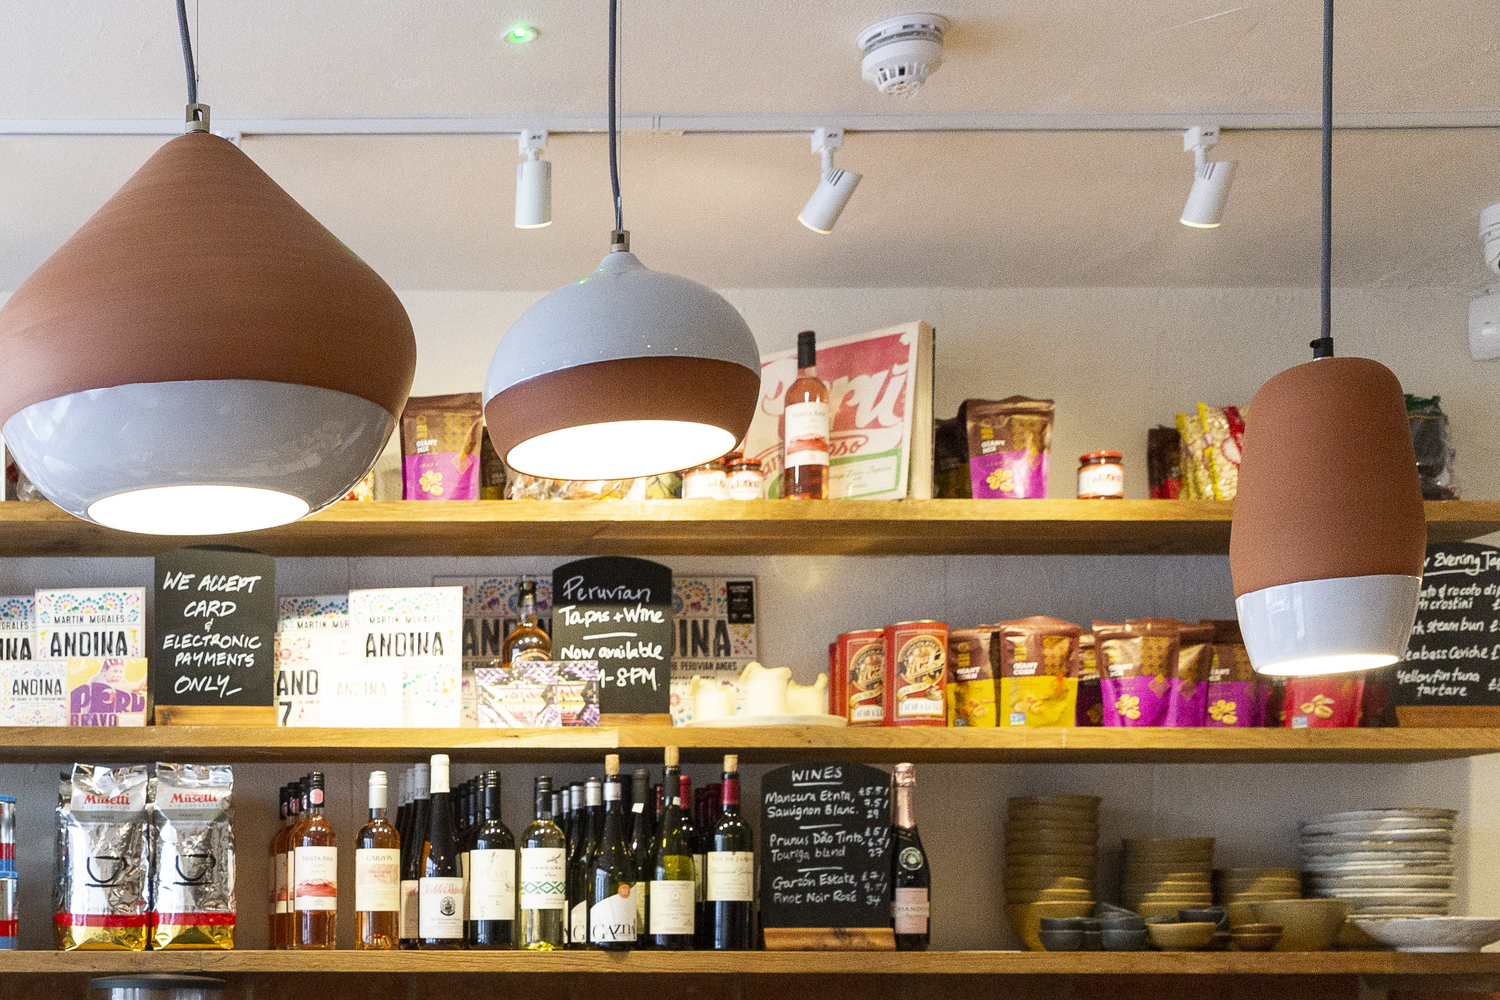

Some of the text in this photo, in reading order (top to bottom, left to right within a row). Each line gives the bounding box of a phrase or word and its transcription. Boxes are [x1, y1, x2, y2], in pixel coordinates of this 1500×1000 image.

[1434, 552, 1481, 576] Evening
[163, 571, 261, 593] WE ACCEPT
[563, 576, 650, 602] Peruvian
[1447, 582, 1482, 596] rocoto
[184, 600, 236, 618] CARD
[1429, 597, 1473, 611] crostini
[54, 614, 126, 624] MARTIN MORALES
[369, 615, 402, 625] MARTIN
[558, 605, 610, 627] Tapas
[204, 618, 214, 632] &
[50, 631, 128, 657] ANDINA
[163, 633, 261, 649] ELECTRONIC
[365, 631, 444, 658] ANDINA
[599, 642, 663, 660] available
[175, 652, 254, 667] PAYMENTS
[1452, 667, 1480, 683] tuna
[12, 678, 62, 696] ANDINA
[1417, 683, 1468, 697] tartare
[70, 713, 117, 726] BRAVO
[792, 766, 842, 781] WINES
[83, 793, 130, 806] Musetti
[765, 792, 815, 804] Mancura
[767, 805, 820, 820] Sauvignon
[770, 833, 808, 847] Prunus
[771, 846, 846, 863] Touriga blend
[772, 872, 816, 891] Garzón
[773, 889, 857, 904] Pinot Noir Rosé
